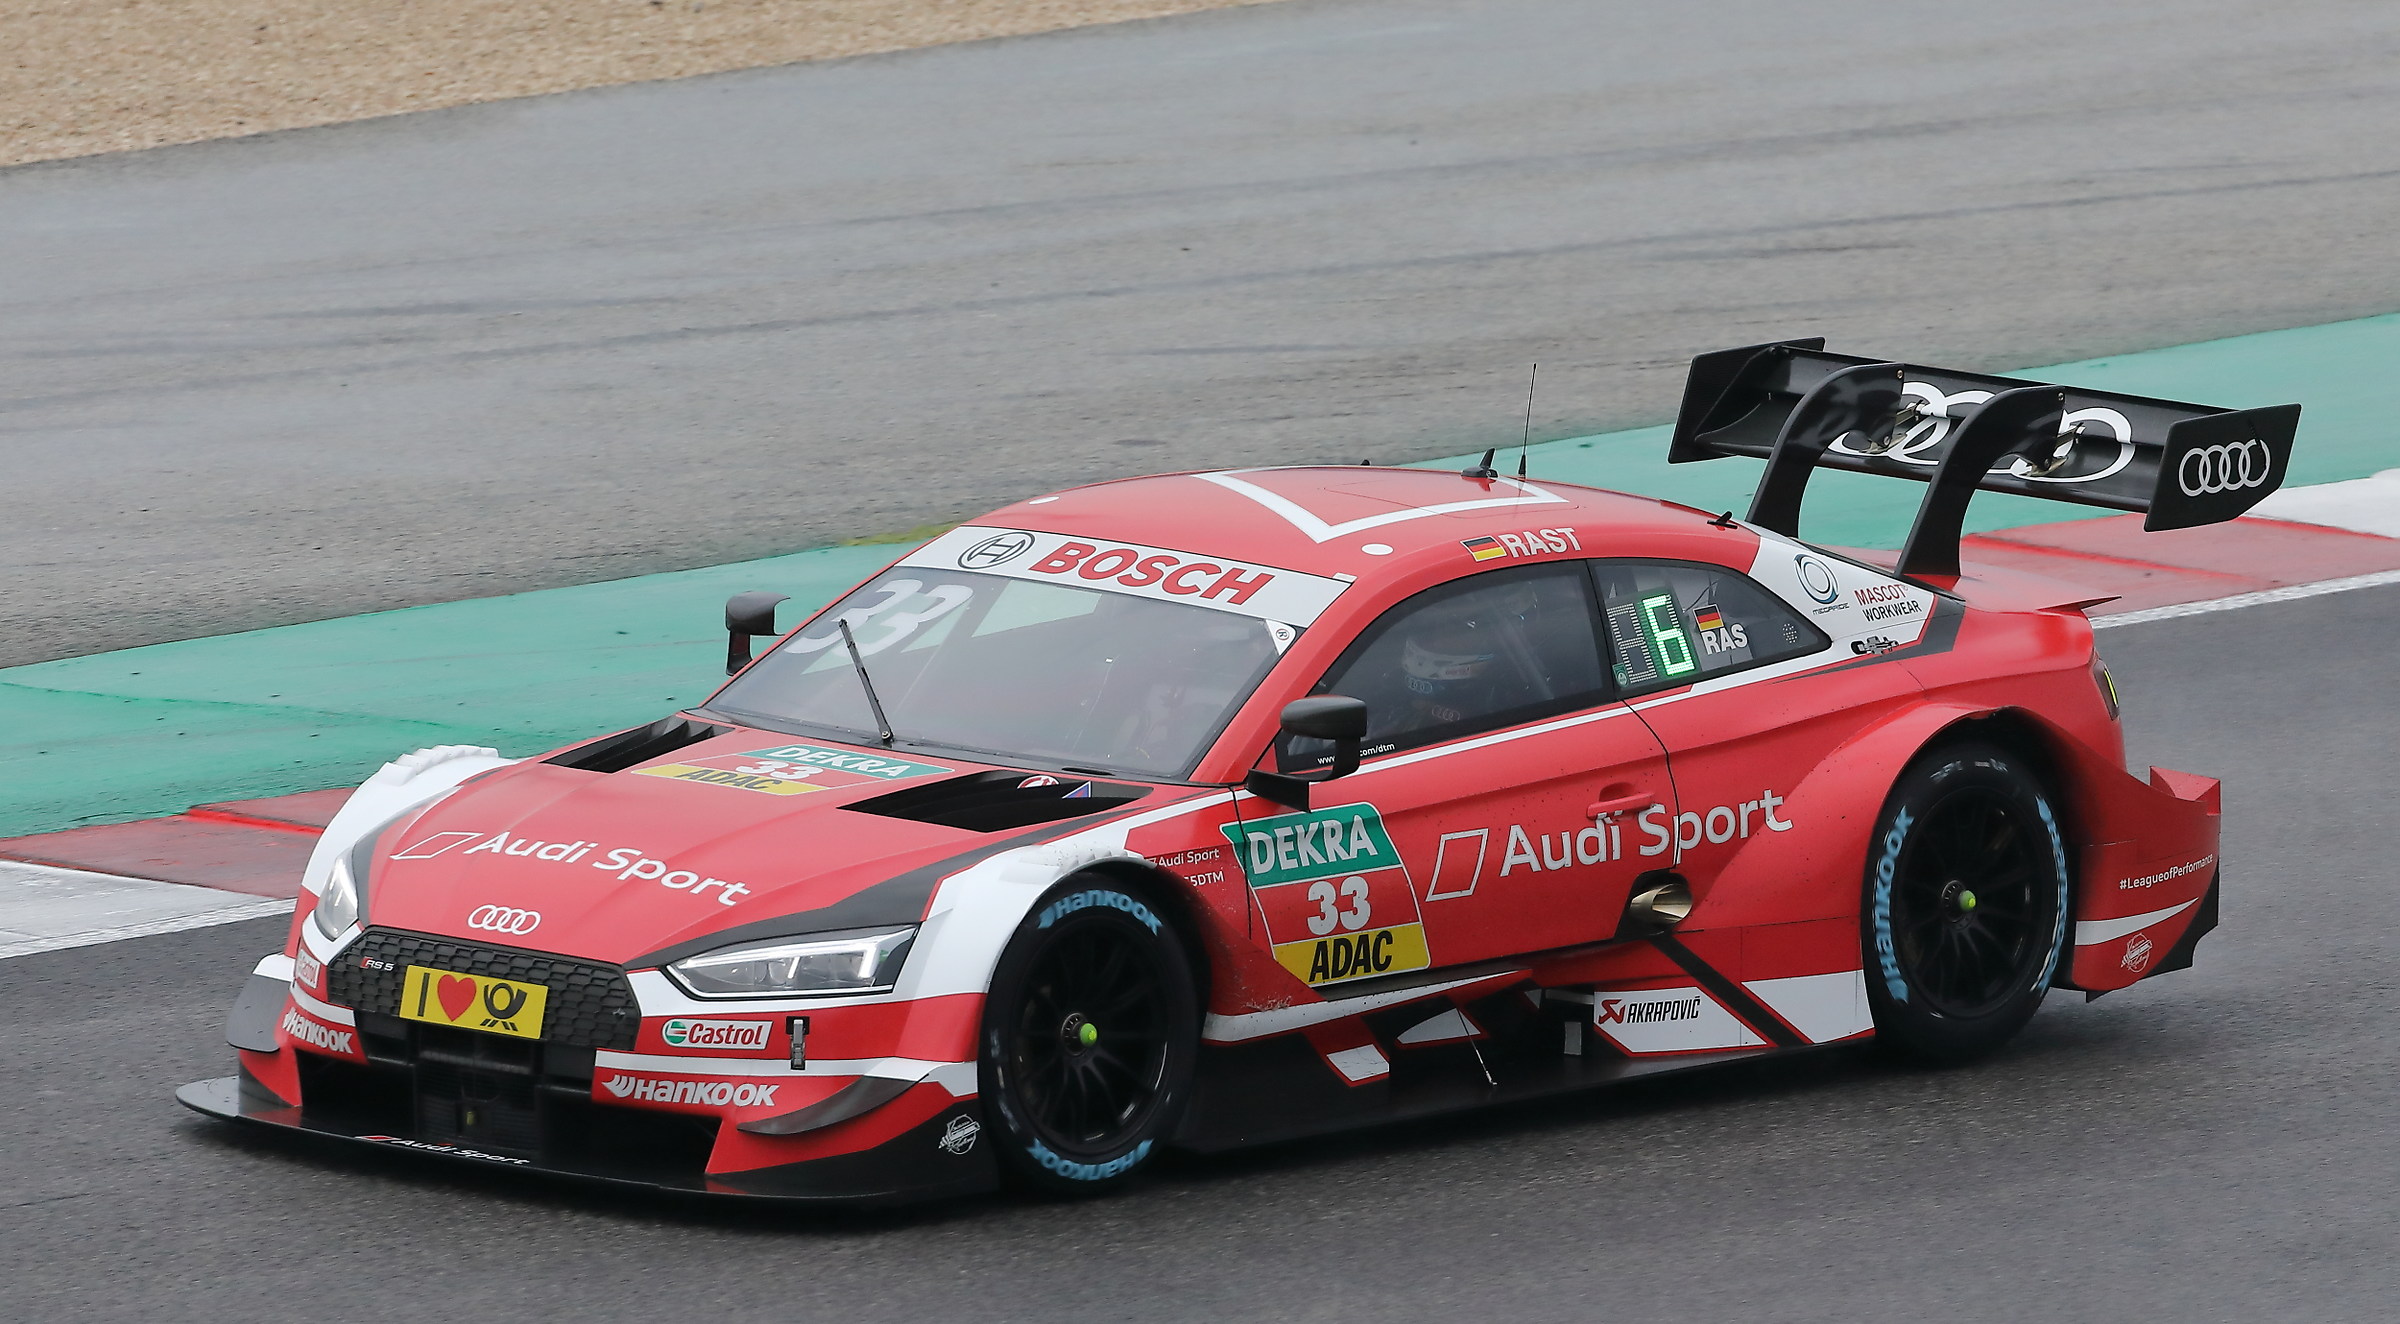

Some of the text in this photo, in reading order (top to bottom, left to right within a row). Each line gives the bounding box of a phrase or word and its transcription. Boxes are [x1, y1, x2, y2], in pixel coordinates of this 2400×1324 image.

[1498, 527, 1581, 558] RAST
[1028, 541, 1276, 606] BOSCH
[783, 578, 974, 659] 33
[1862, 600, 1922, 622] WORKWEAR
[1701, 623, 1748, 655] RAS
[736, 761, 824, 780] 33
[766, 747, 911, 777] DEKRA
[675, 769, 783, 790] ADAC
[1247, 814, 1379, 875] DEKRA
[1500, 789, 1794, 877] Audi Sport
[462, 831, 752, 907] Audi Sport
[1158, 848, 1220, 868] Audi Sport
[2119, 853, 2213, 890] #LeagueofPerformance
[1183, 870, 1225, 887] 5DTM
[1306, 875, 1372, 936] 33
[1308, 930, 1394, 983] ADAC
[417, 972, 431, 1017] I
[688, 1023, 764, 1046] Castrol
[391, 1138, 531, 1165] Audi Sport
